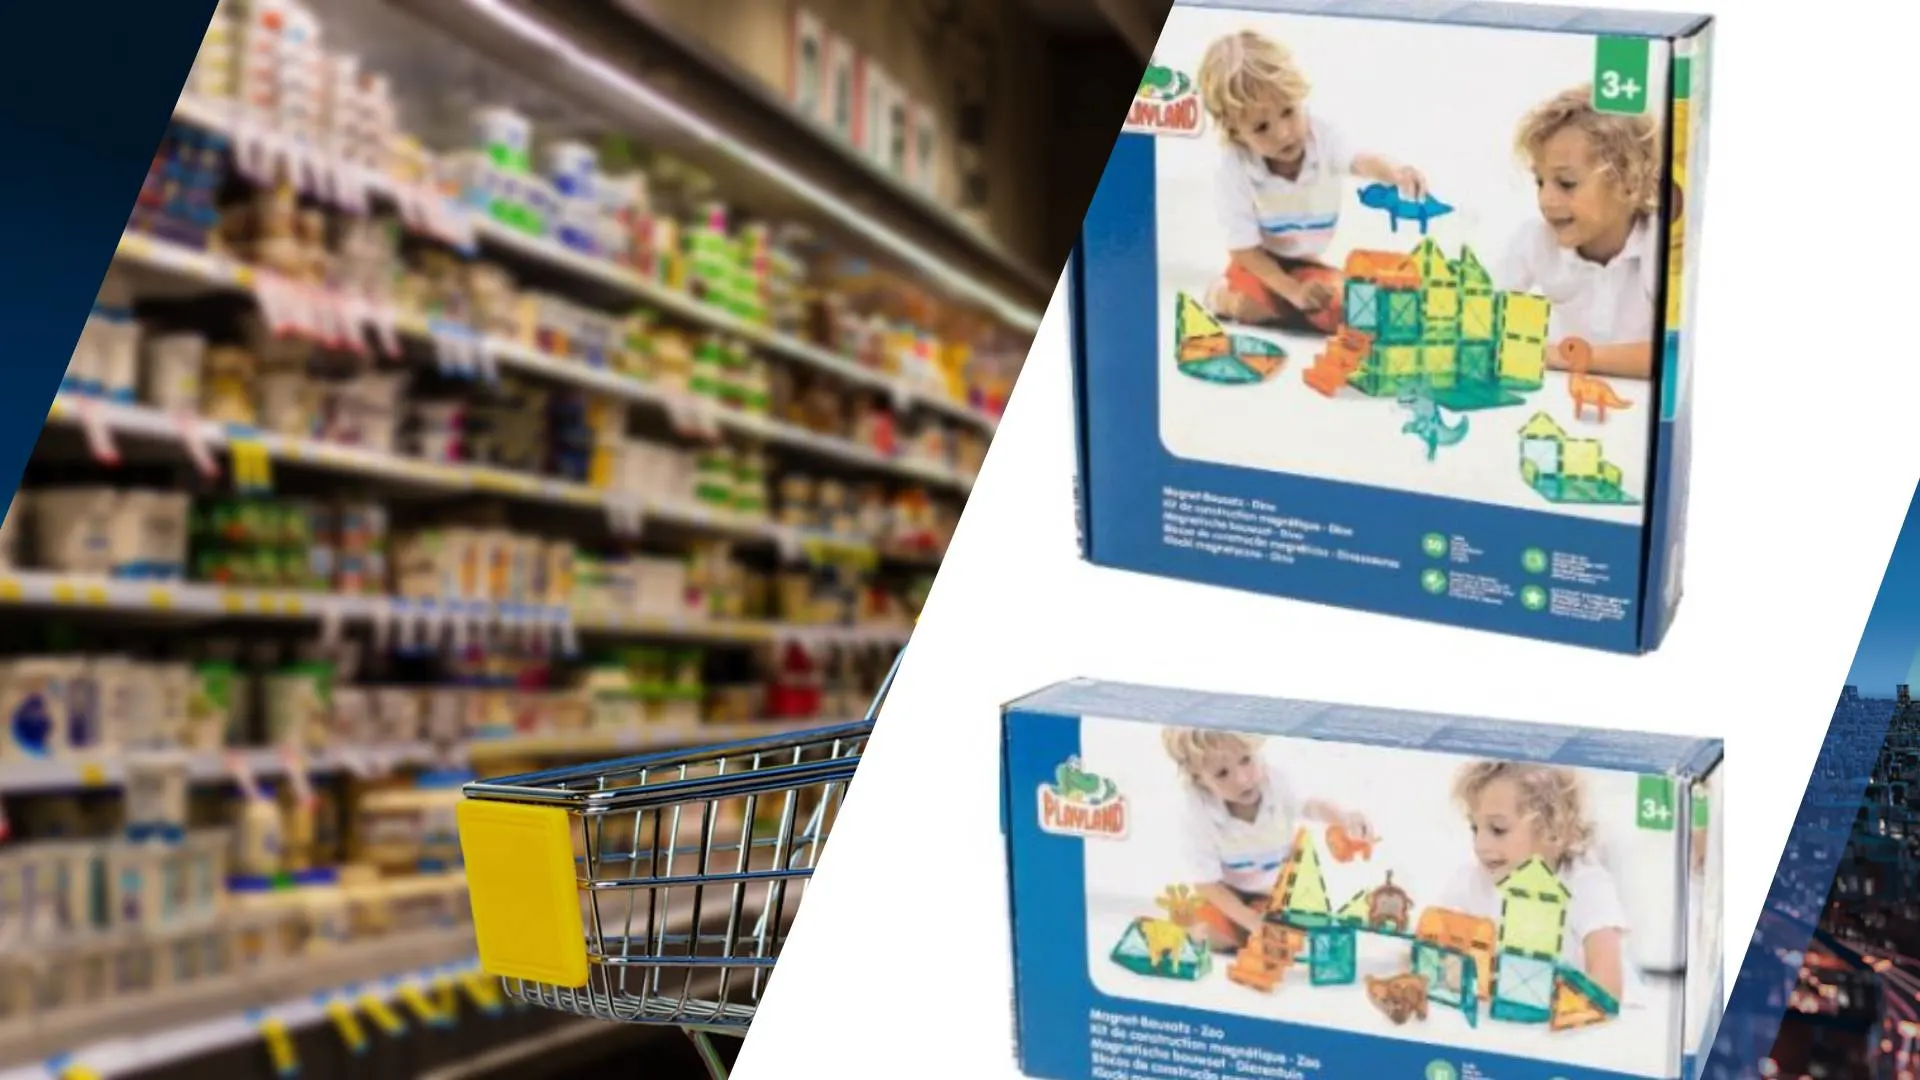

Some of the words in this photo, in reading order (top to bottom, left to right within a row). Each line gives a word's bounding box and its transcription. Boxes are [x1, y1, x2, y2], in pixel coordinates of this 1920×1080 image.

[1601, 70, 1642, 100] 3+
[1162, 499, 1178, 509] Kit
[1179, 502, 1193, 512] de
[1194, 505, 1258, 522] construction
[1197, 528, 1210, 539] de
[1043, 789, 1124, 834] PLAYLAND
[1641, 798, 1672, 821] 3+
[1089, 1008, 1191, 1034] Magnet-Bausatz
[1200, 1024, 1225, 1040] Zoo
[1090, 1023, 1108, 1036] Kit
[1110, 1027, 1127, 1039] de
[1129, 1031, 1208, 1052] construction
[1296, 1053, 1320, 1070] Zoo
[1090, 1037, 1170, 1060] Magnetische
[1173, 1048, 1225, 1068] bouwset
[1236, 1059, 1304, 1080] Dierentuin
[1091, 1051, 1131, 1068] Blocos
[1132, 1058, 1149, 1071] de
